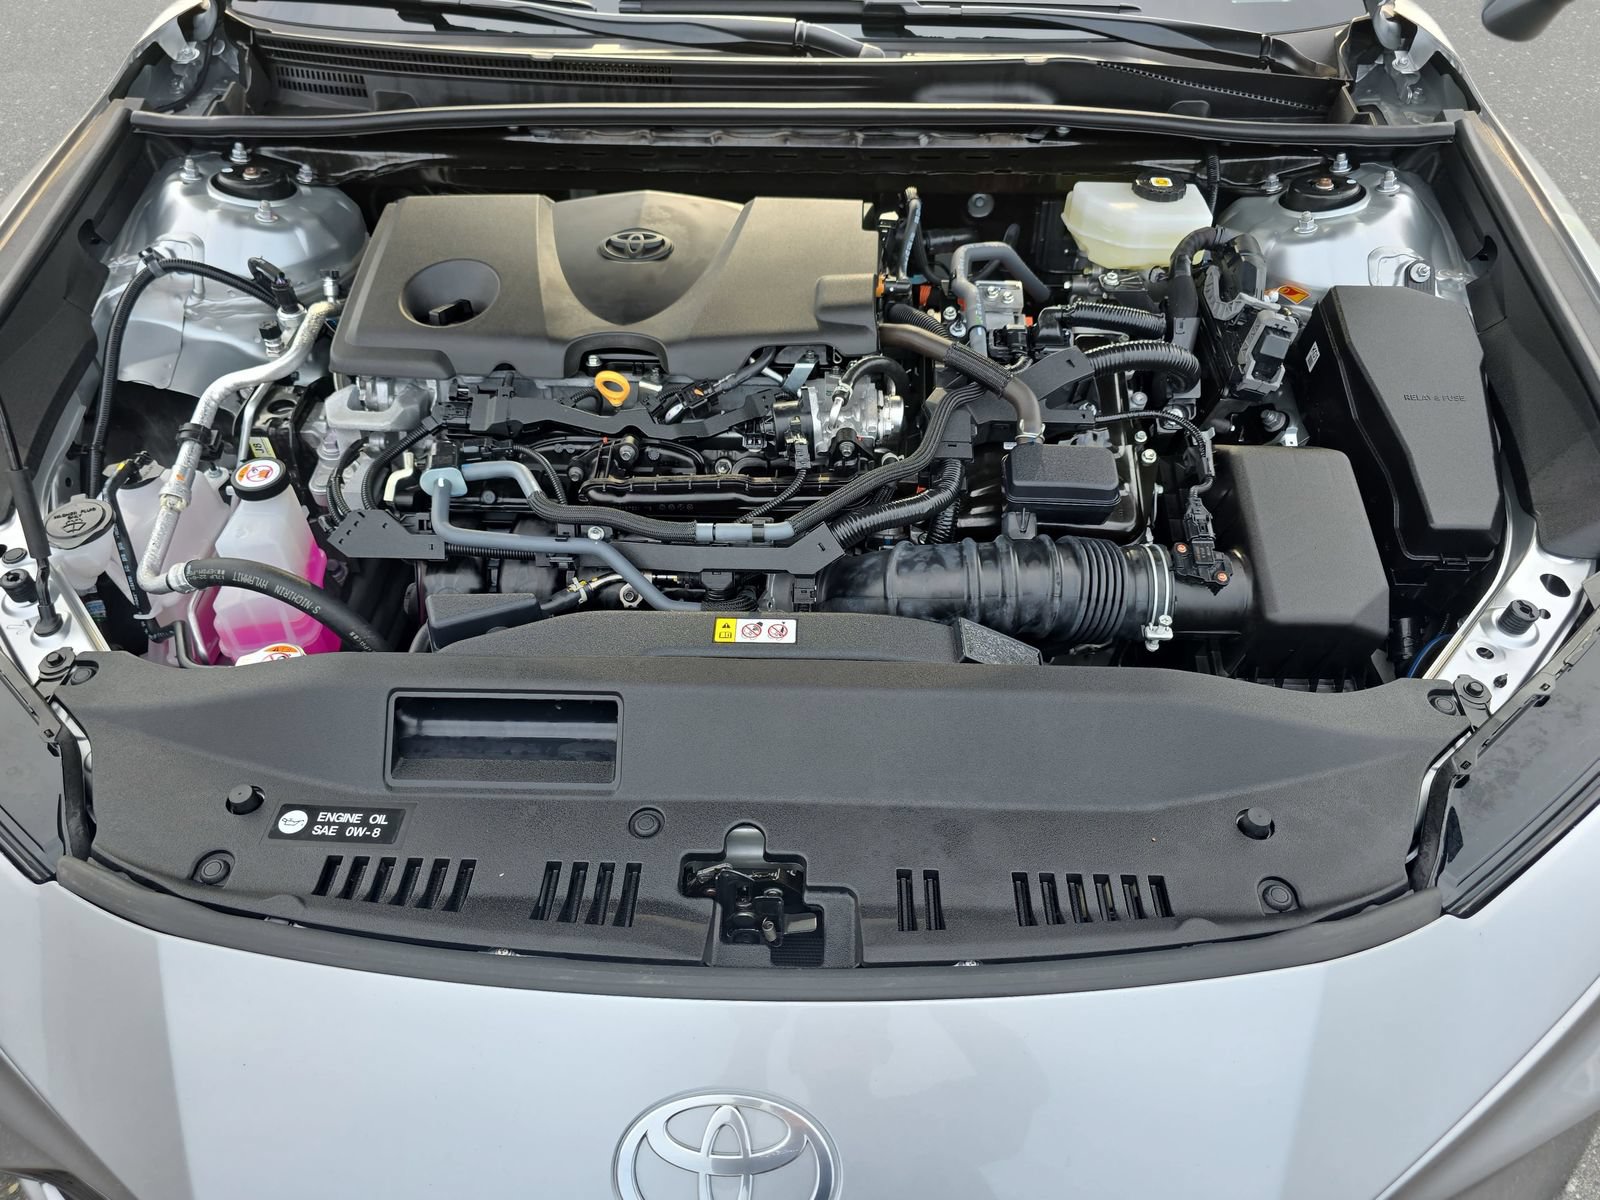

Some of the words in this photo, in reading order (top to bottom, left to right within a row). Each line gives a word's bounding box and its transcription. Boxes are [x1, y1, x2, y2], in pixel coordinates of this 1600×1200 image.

[1442, 394, 1466, 402] FUSE
[316, 811, 363, 823] ENGINE
[369, 814, 389, 825] OIL
[311, 825, 339, 836] SAE
[345, 826, 381, 838] 0W-8
